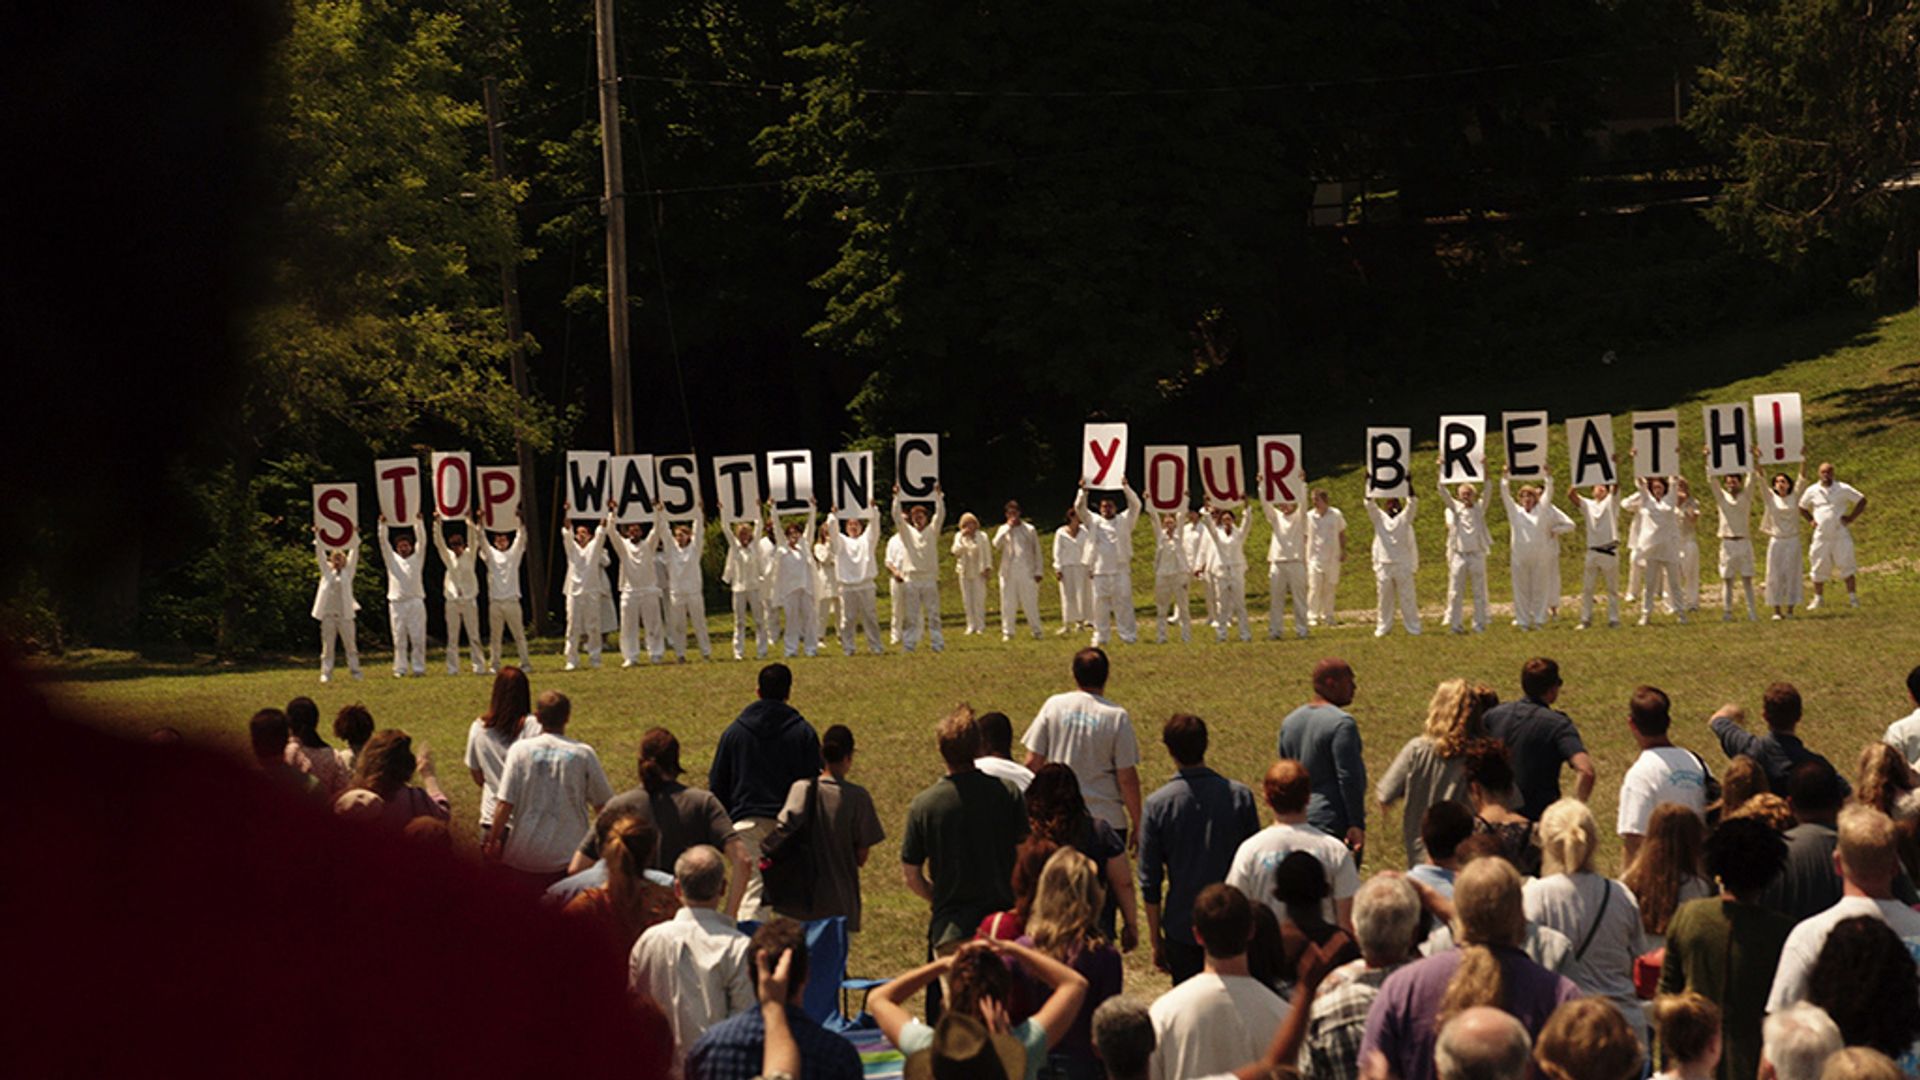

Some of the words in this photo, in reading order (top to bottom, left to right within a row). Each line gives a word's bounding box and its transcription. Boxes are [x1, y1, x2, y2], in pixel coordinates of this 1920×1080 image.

[317, 456, 516, 547] STOP
[569, 438, 937, 518] WASTING
[1089, 437, 1296, 510] YOUR
[1370, 401, 1786, 491] BREATH!
